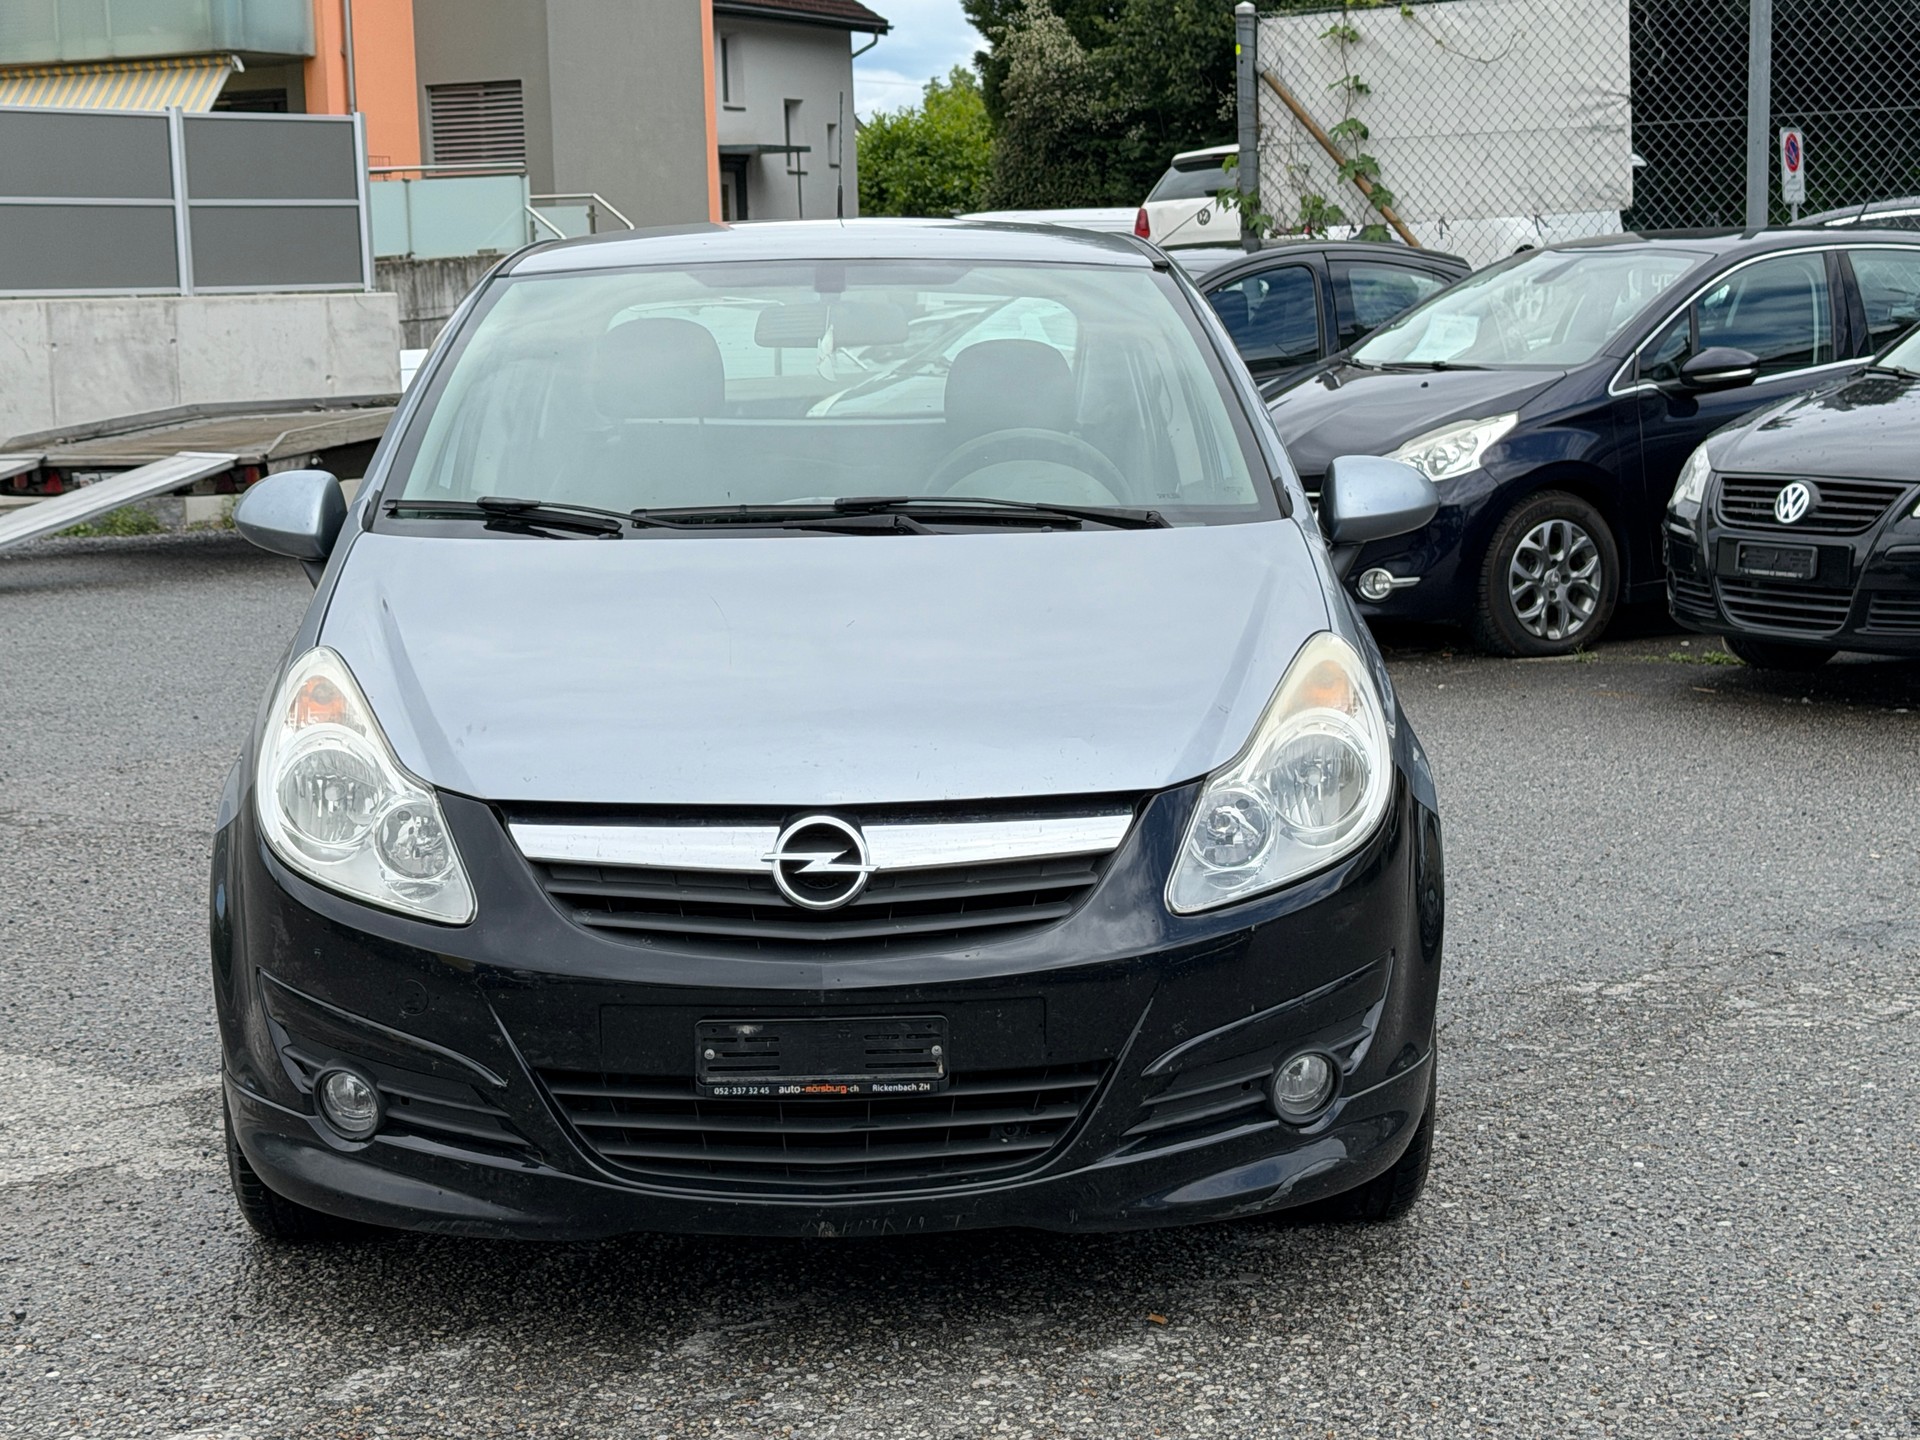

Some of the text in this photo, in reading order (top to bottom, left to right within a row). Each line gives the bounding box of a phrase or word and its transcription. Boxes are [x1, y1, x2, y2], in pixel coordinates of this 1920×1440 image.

[748, 1086, 758, 1095] 32
[759, 1086, 770, 1094] 45
[872, 1082, 931, 1092] Rickenbach ZH
